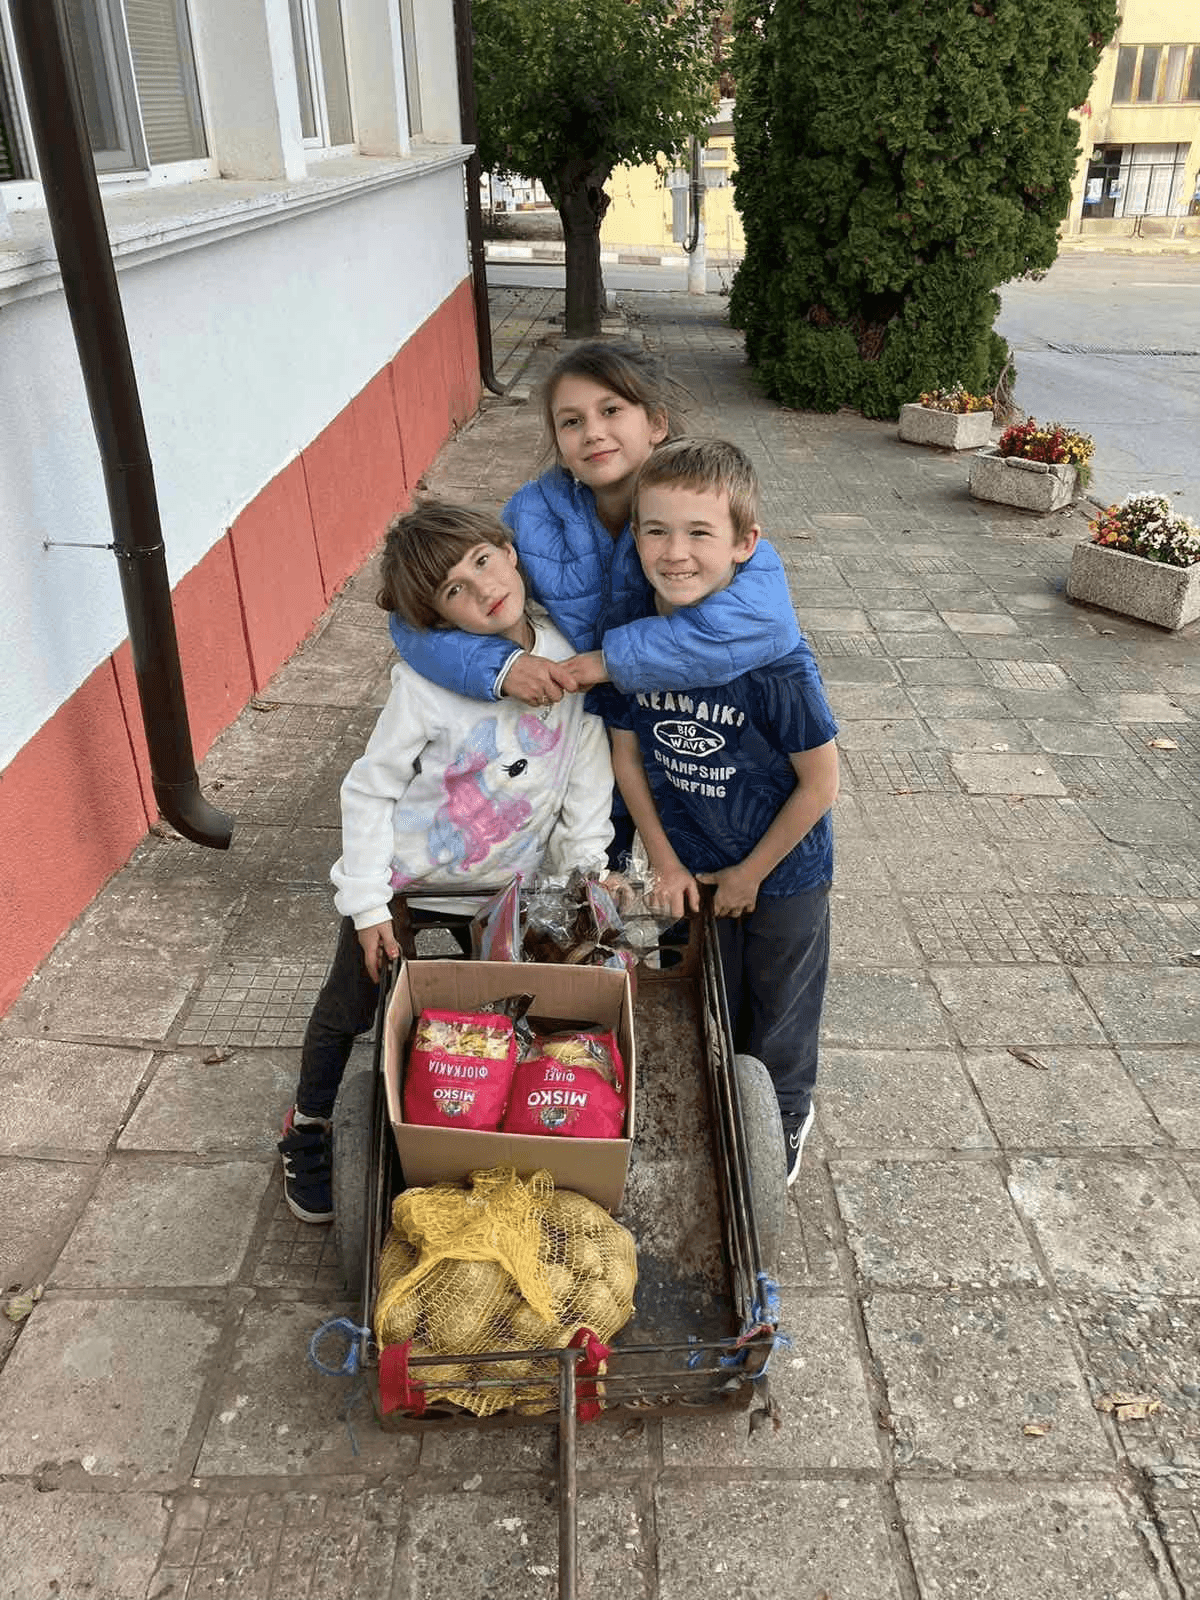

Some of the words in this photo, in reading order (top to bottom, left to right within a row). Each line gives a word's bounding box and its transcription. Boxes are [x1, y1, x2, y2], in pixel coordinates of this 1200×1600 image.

[677, 725, 696, 738] BIG
[670, 737, 707, 751] WAVE
[654, 749, 737, 781] CHAMPSHIP
[665, 770, 727, 798] SURFING
[433, 1088, 476, 1102] MISKO
[527, 1090, 588, 1108] MISKO
